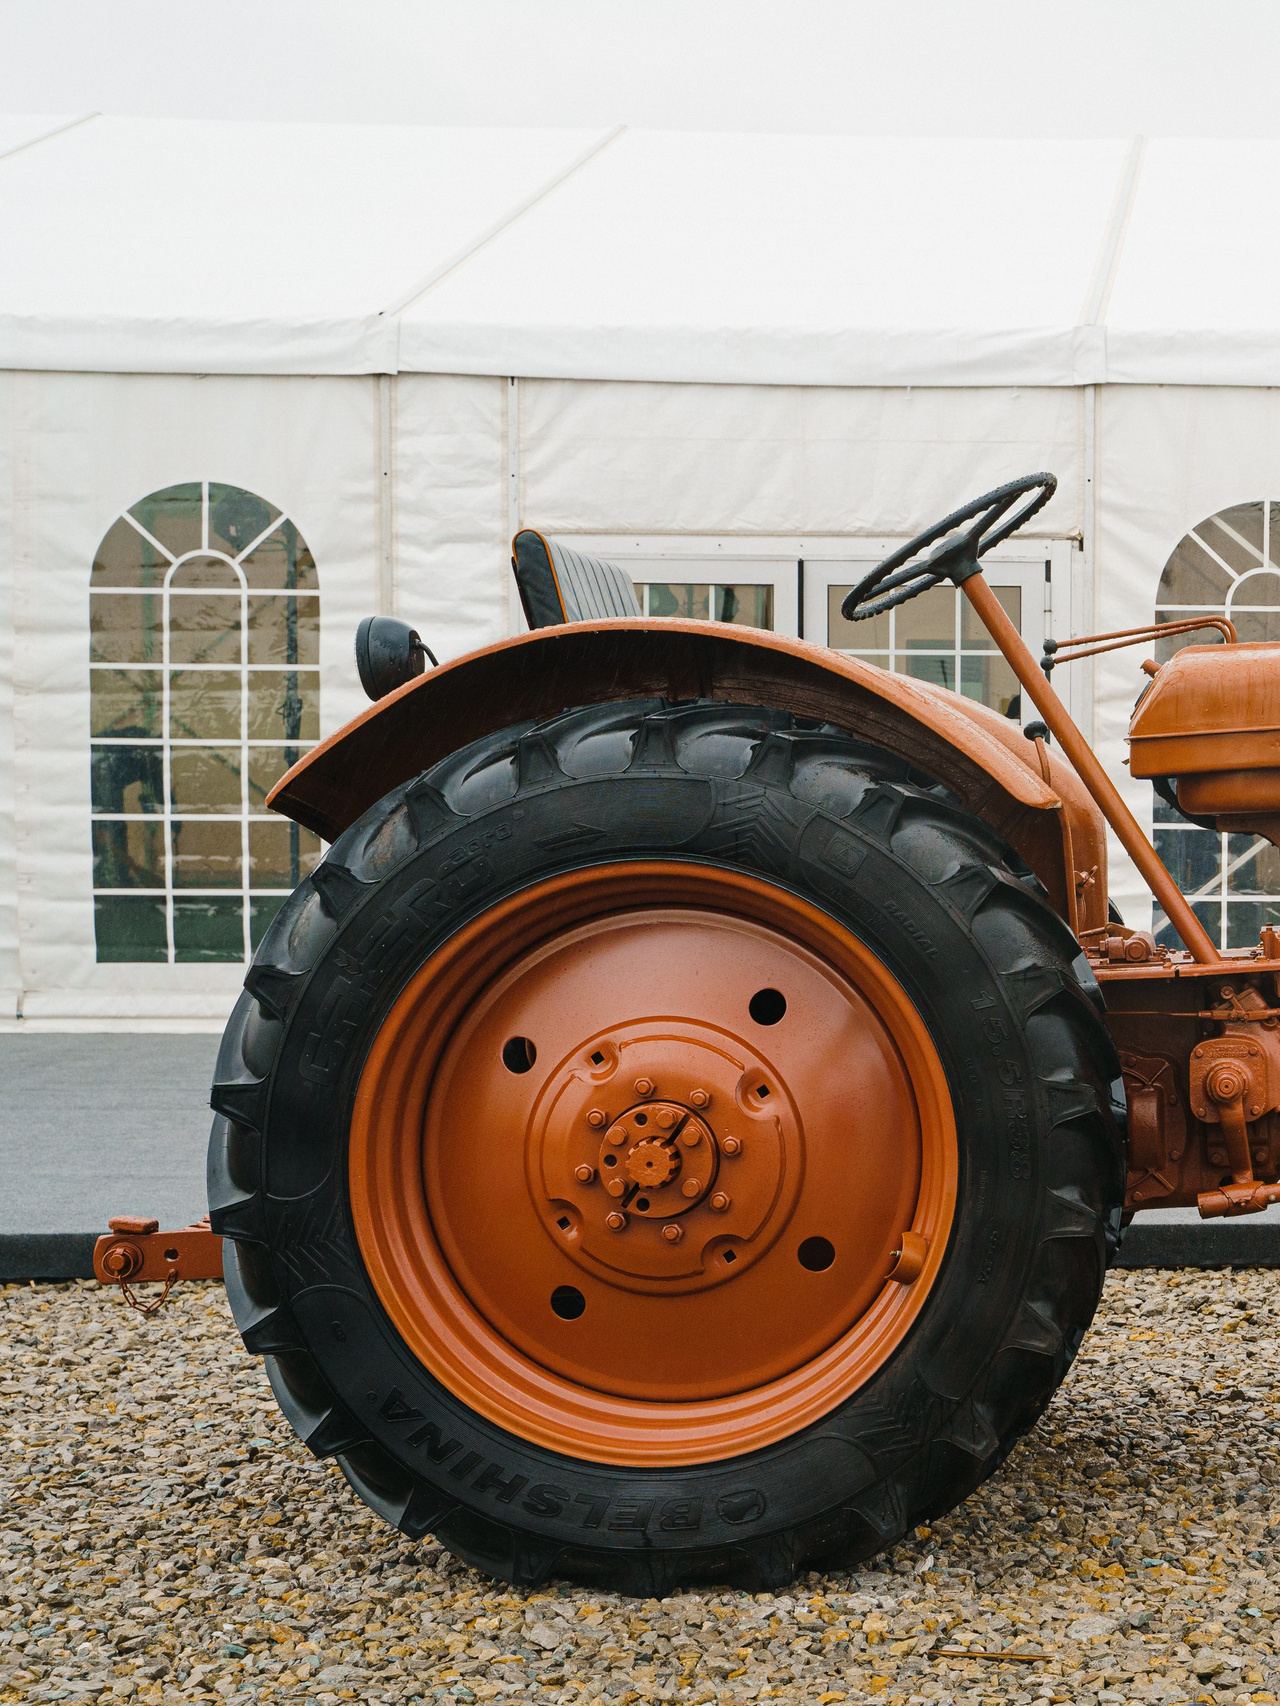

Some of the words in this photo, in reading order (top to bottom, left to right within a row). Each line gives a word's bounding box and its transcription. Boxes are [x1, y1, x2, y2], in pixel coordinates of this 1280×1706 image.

[884, 899, 940, 960] RADIAL
[970, 988, 1032, 1180] 15.5R38
[379, 1387, 705, 1532] BELSHINA
